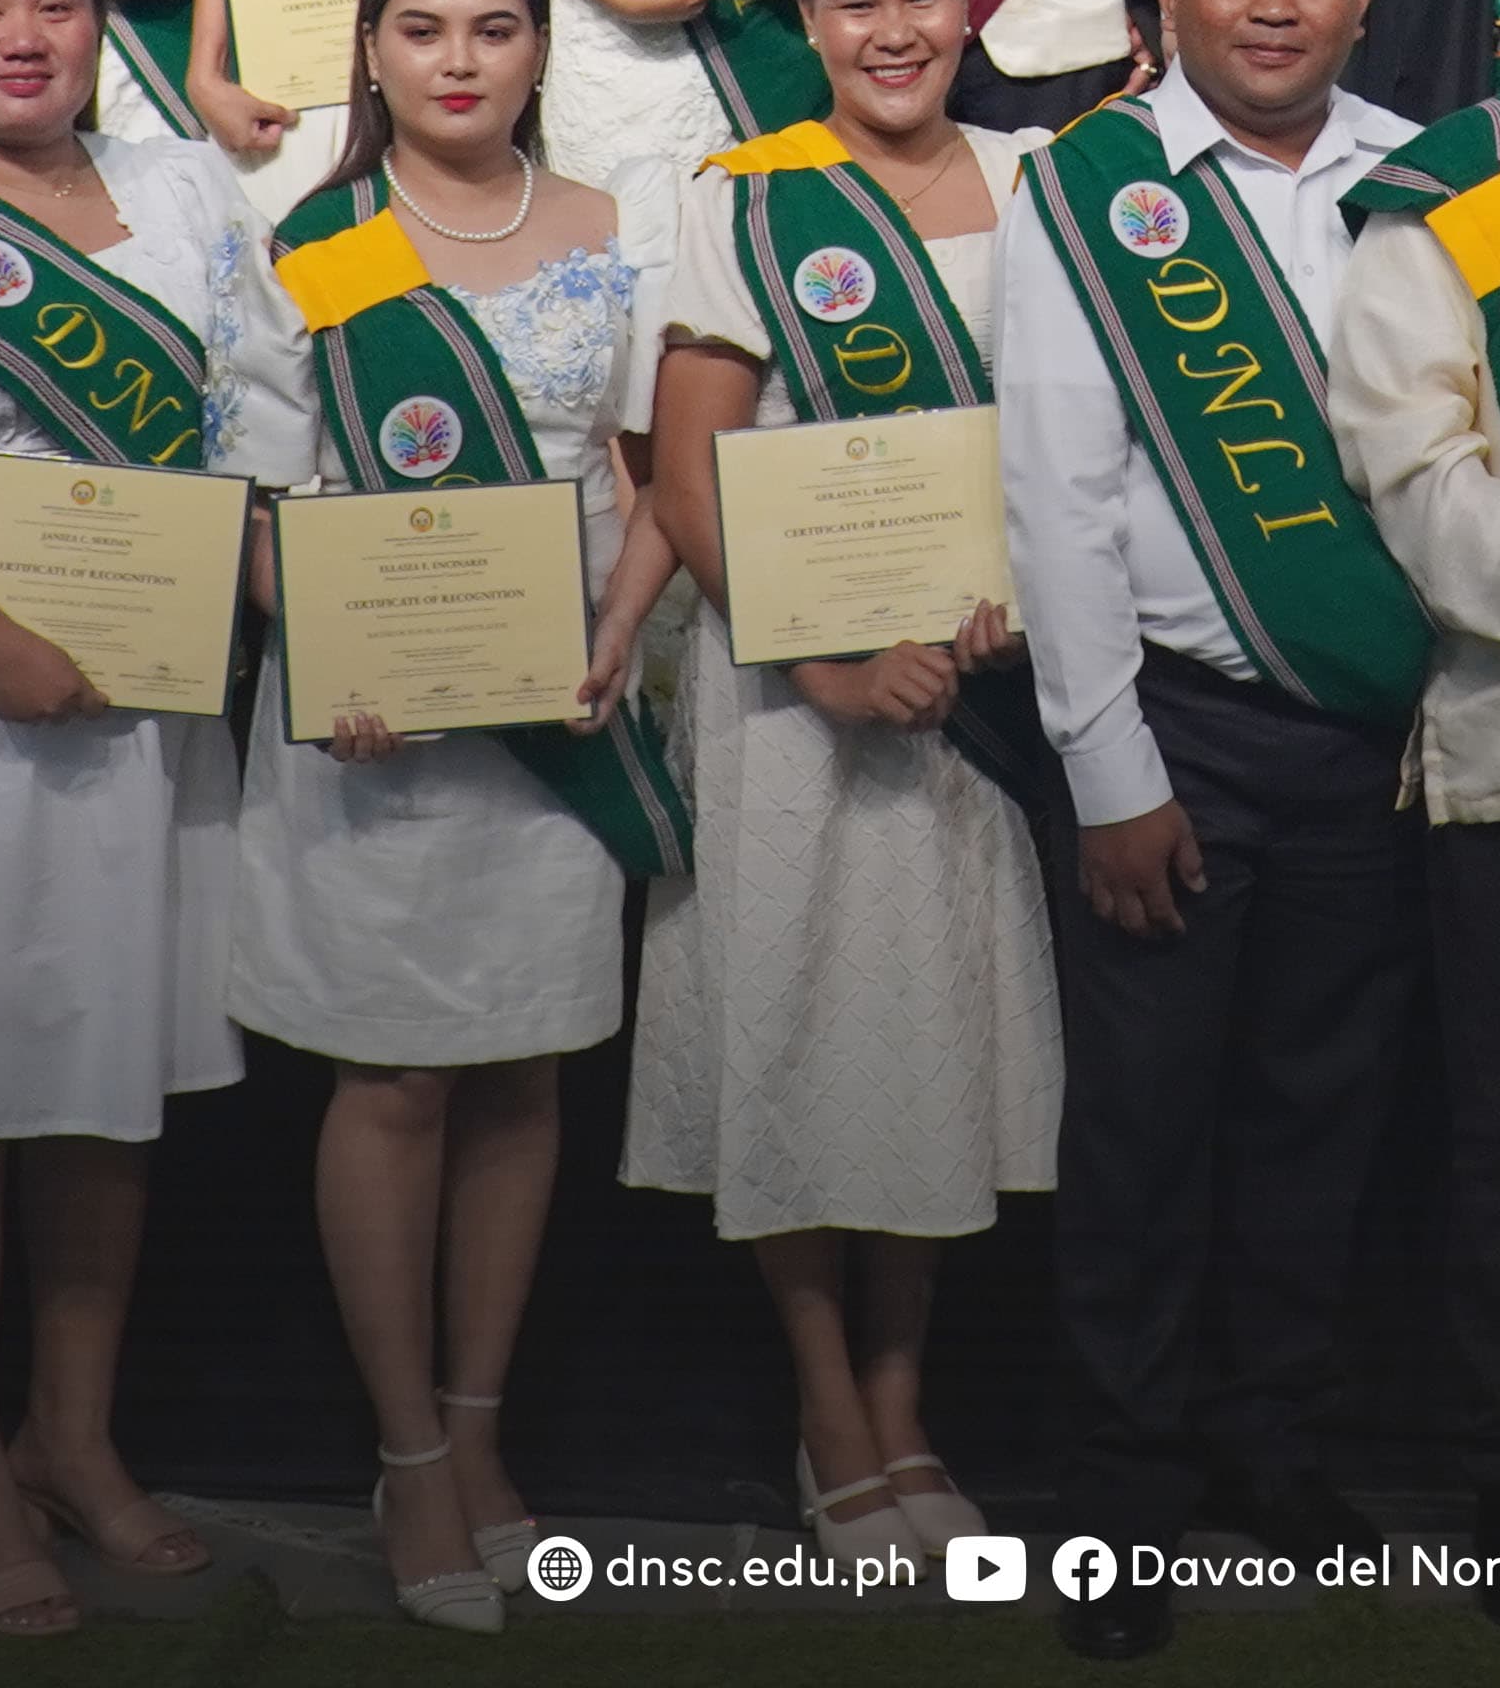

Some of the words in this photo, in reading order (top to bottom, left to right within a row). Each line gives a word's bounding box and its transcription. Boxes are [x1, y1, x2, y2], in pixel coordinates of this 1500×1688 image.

[1146, 257, 1340, 543] DNLI
[783, 521, 858, 539] CERTIFICATE
[860, 518, 877, 532] OF
[879, 509, 964, 530] RECOGNITION
[69, 567, 87, 579] OF
[89, 568, 177, 587] RECOGNITION
[345, 595, 421, 612] CERTIFICATE
[422, 593, 440, 606] OF
[441, 588, 527, 604] RECOGNITION
